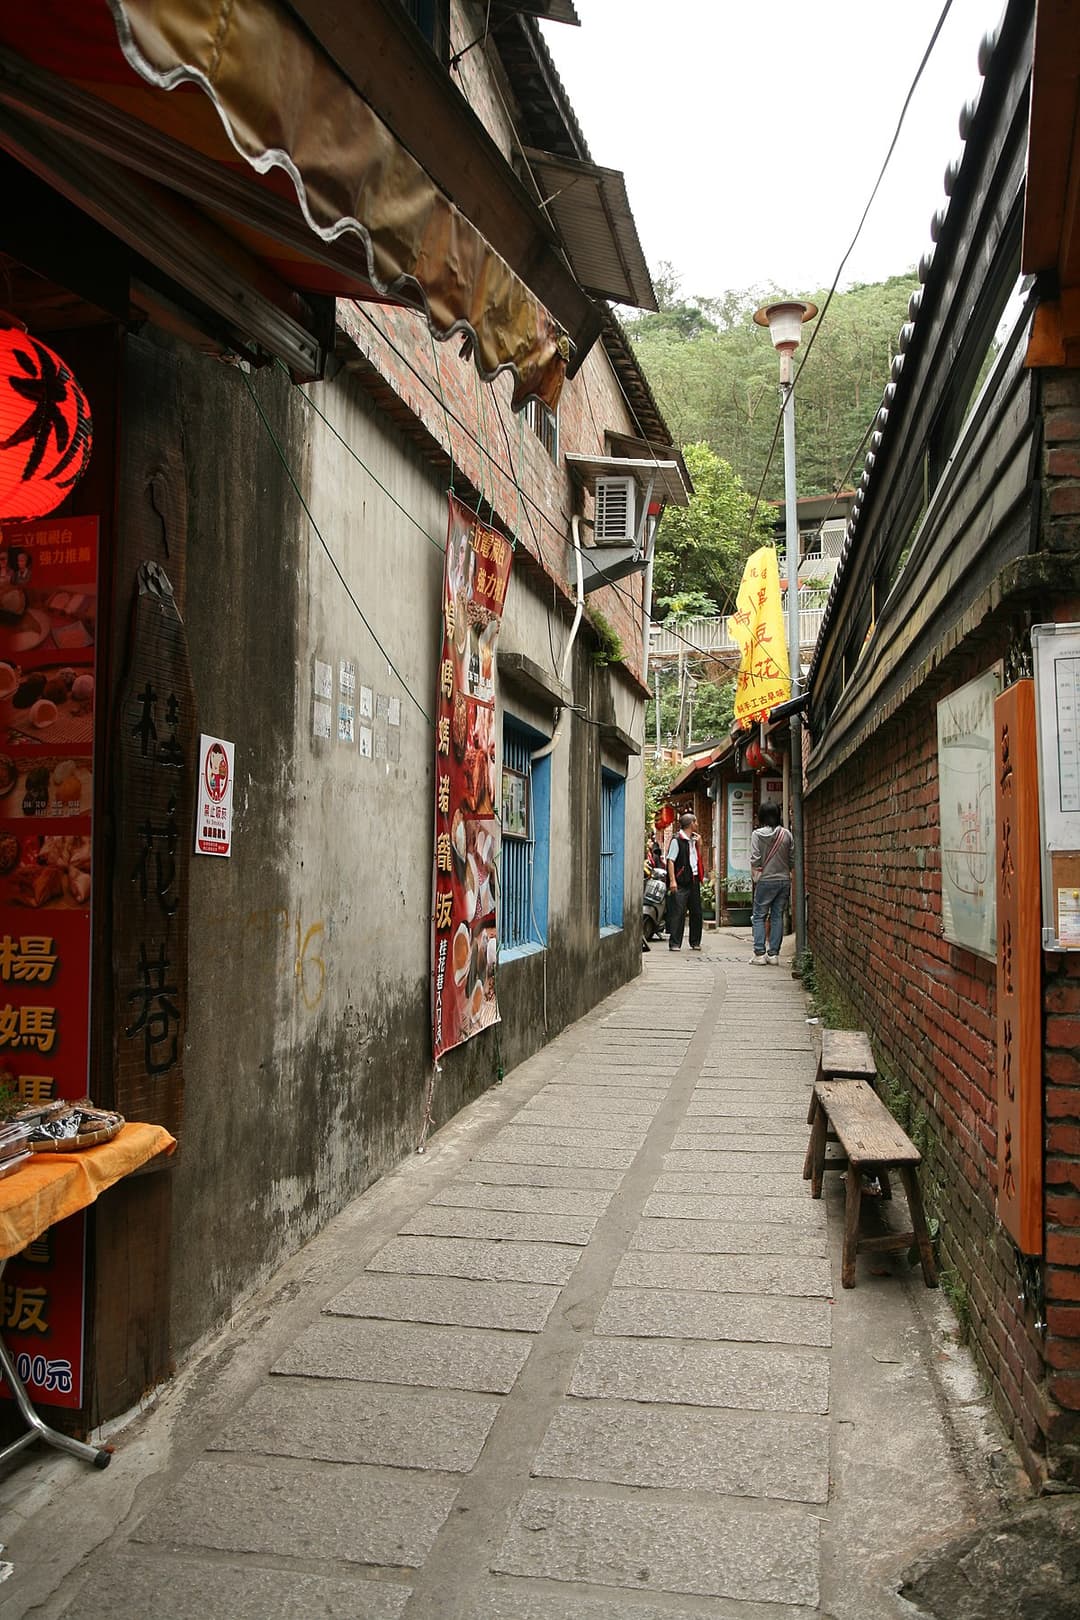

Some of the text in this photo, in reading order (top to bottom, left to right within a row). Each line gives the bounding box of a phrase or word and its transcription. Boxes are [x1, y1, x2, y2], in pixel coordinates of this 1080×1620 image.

[10, 528, 73, 548] 三立電視台
